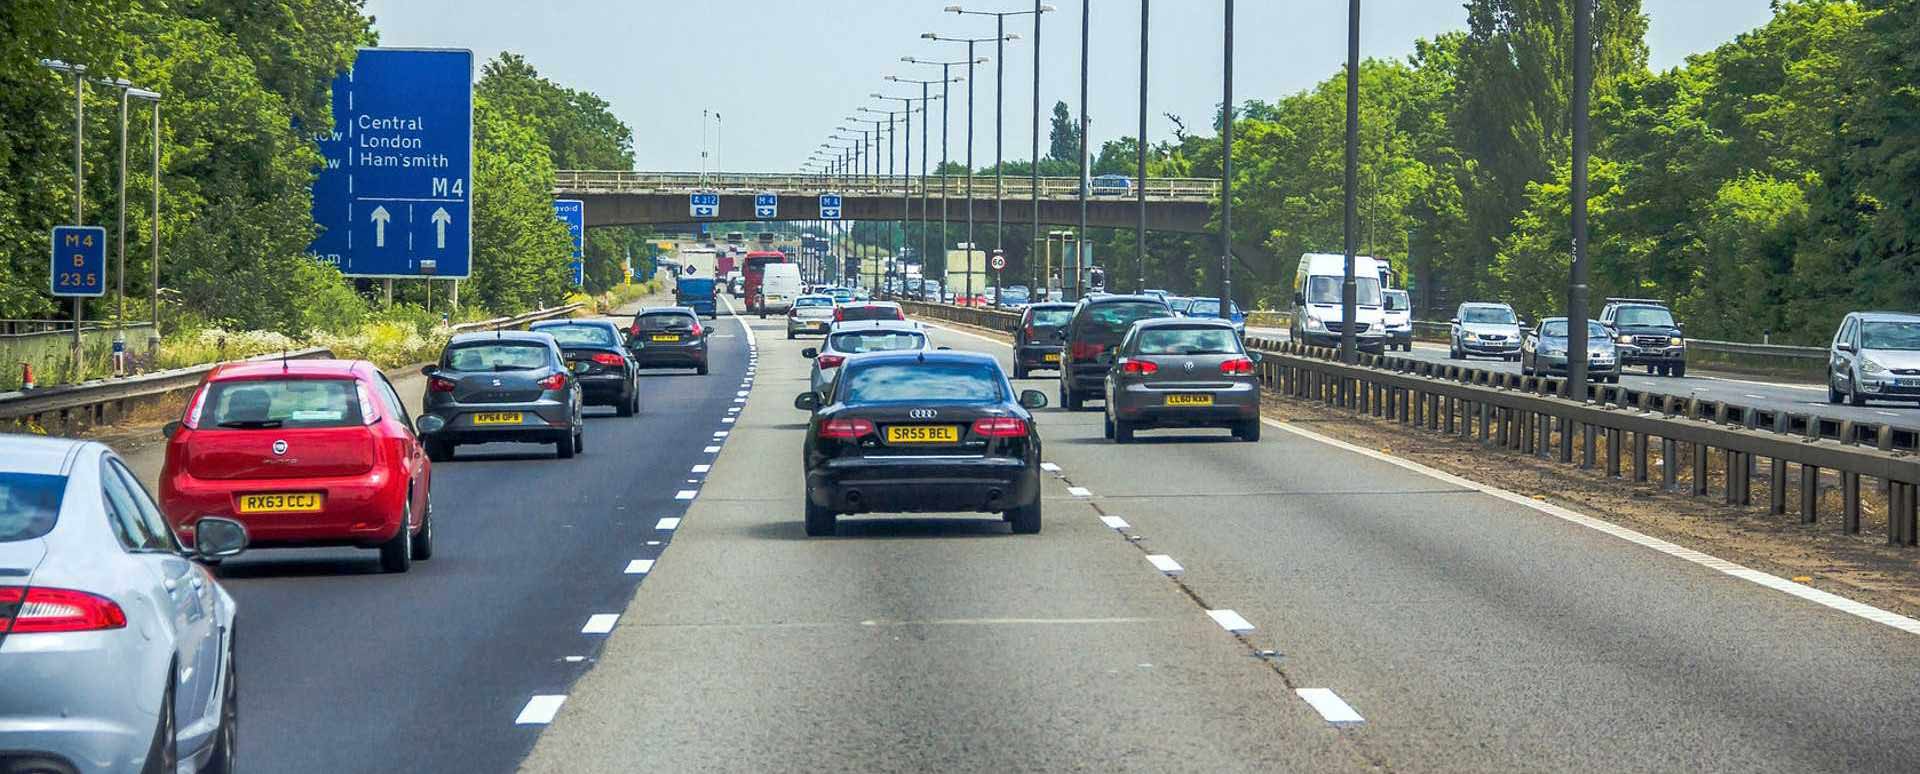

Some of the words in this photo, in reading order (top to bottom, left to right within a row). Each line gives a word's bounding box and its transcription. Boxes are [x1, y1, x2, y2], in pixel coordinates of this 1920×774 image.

[358, 114, 423, 130] Central
[360, 134, 421, 148] London
[360, 152, 448, 167] Ham'smith
[73, 254, 84, 267] B
[993, 258, 1004, 266] 60
[60, 272, 96, 286] 23.5
[894, 427, 925, 440] SR55
[929, 427, 952, 440] BEL
[247, 495, 283, 509] RX63
[287, 494, 315, 507] CCJ
